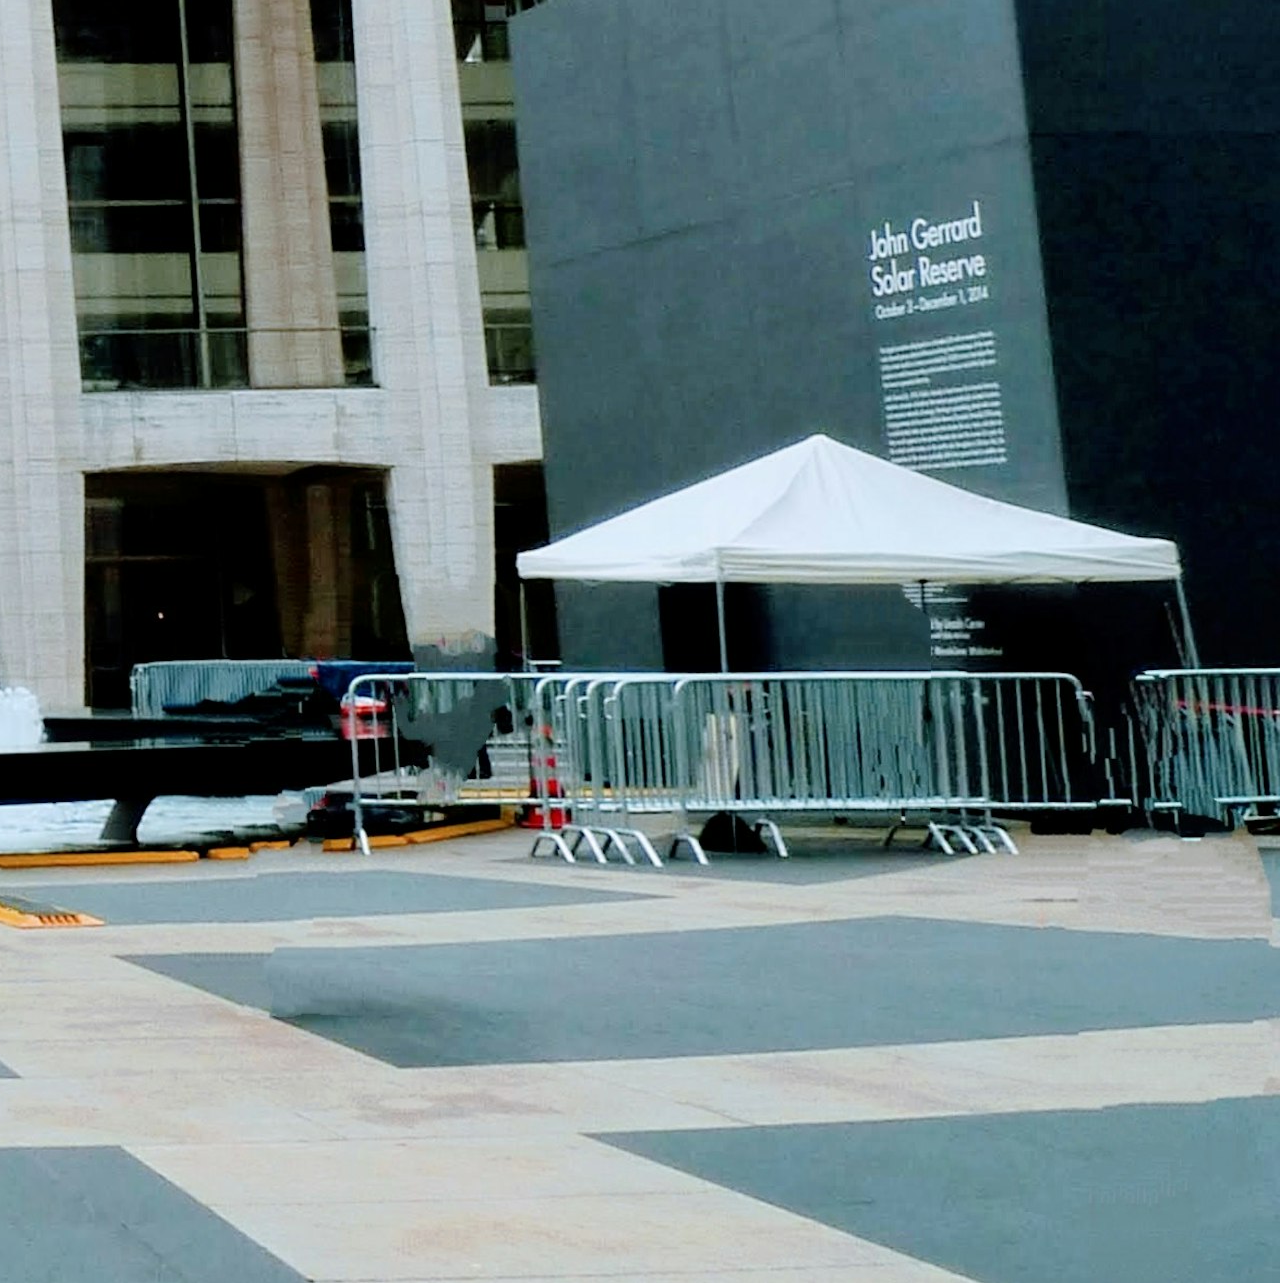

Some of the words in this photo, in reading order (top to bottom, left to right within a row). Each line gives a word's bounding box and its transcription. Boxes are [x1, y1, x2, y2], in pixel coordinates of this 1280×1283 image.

[868, 221, 909, 261] John
[910, 199, 983, 250] Gerrard
[870, 257, 916, 297] Solar
[917, 254, 987, 288] Reserve
